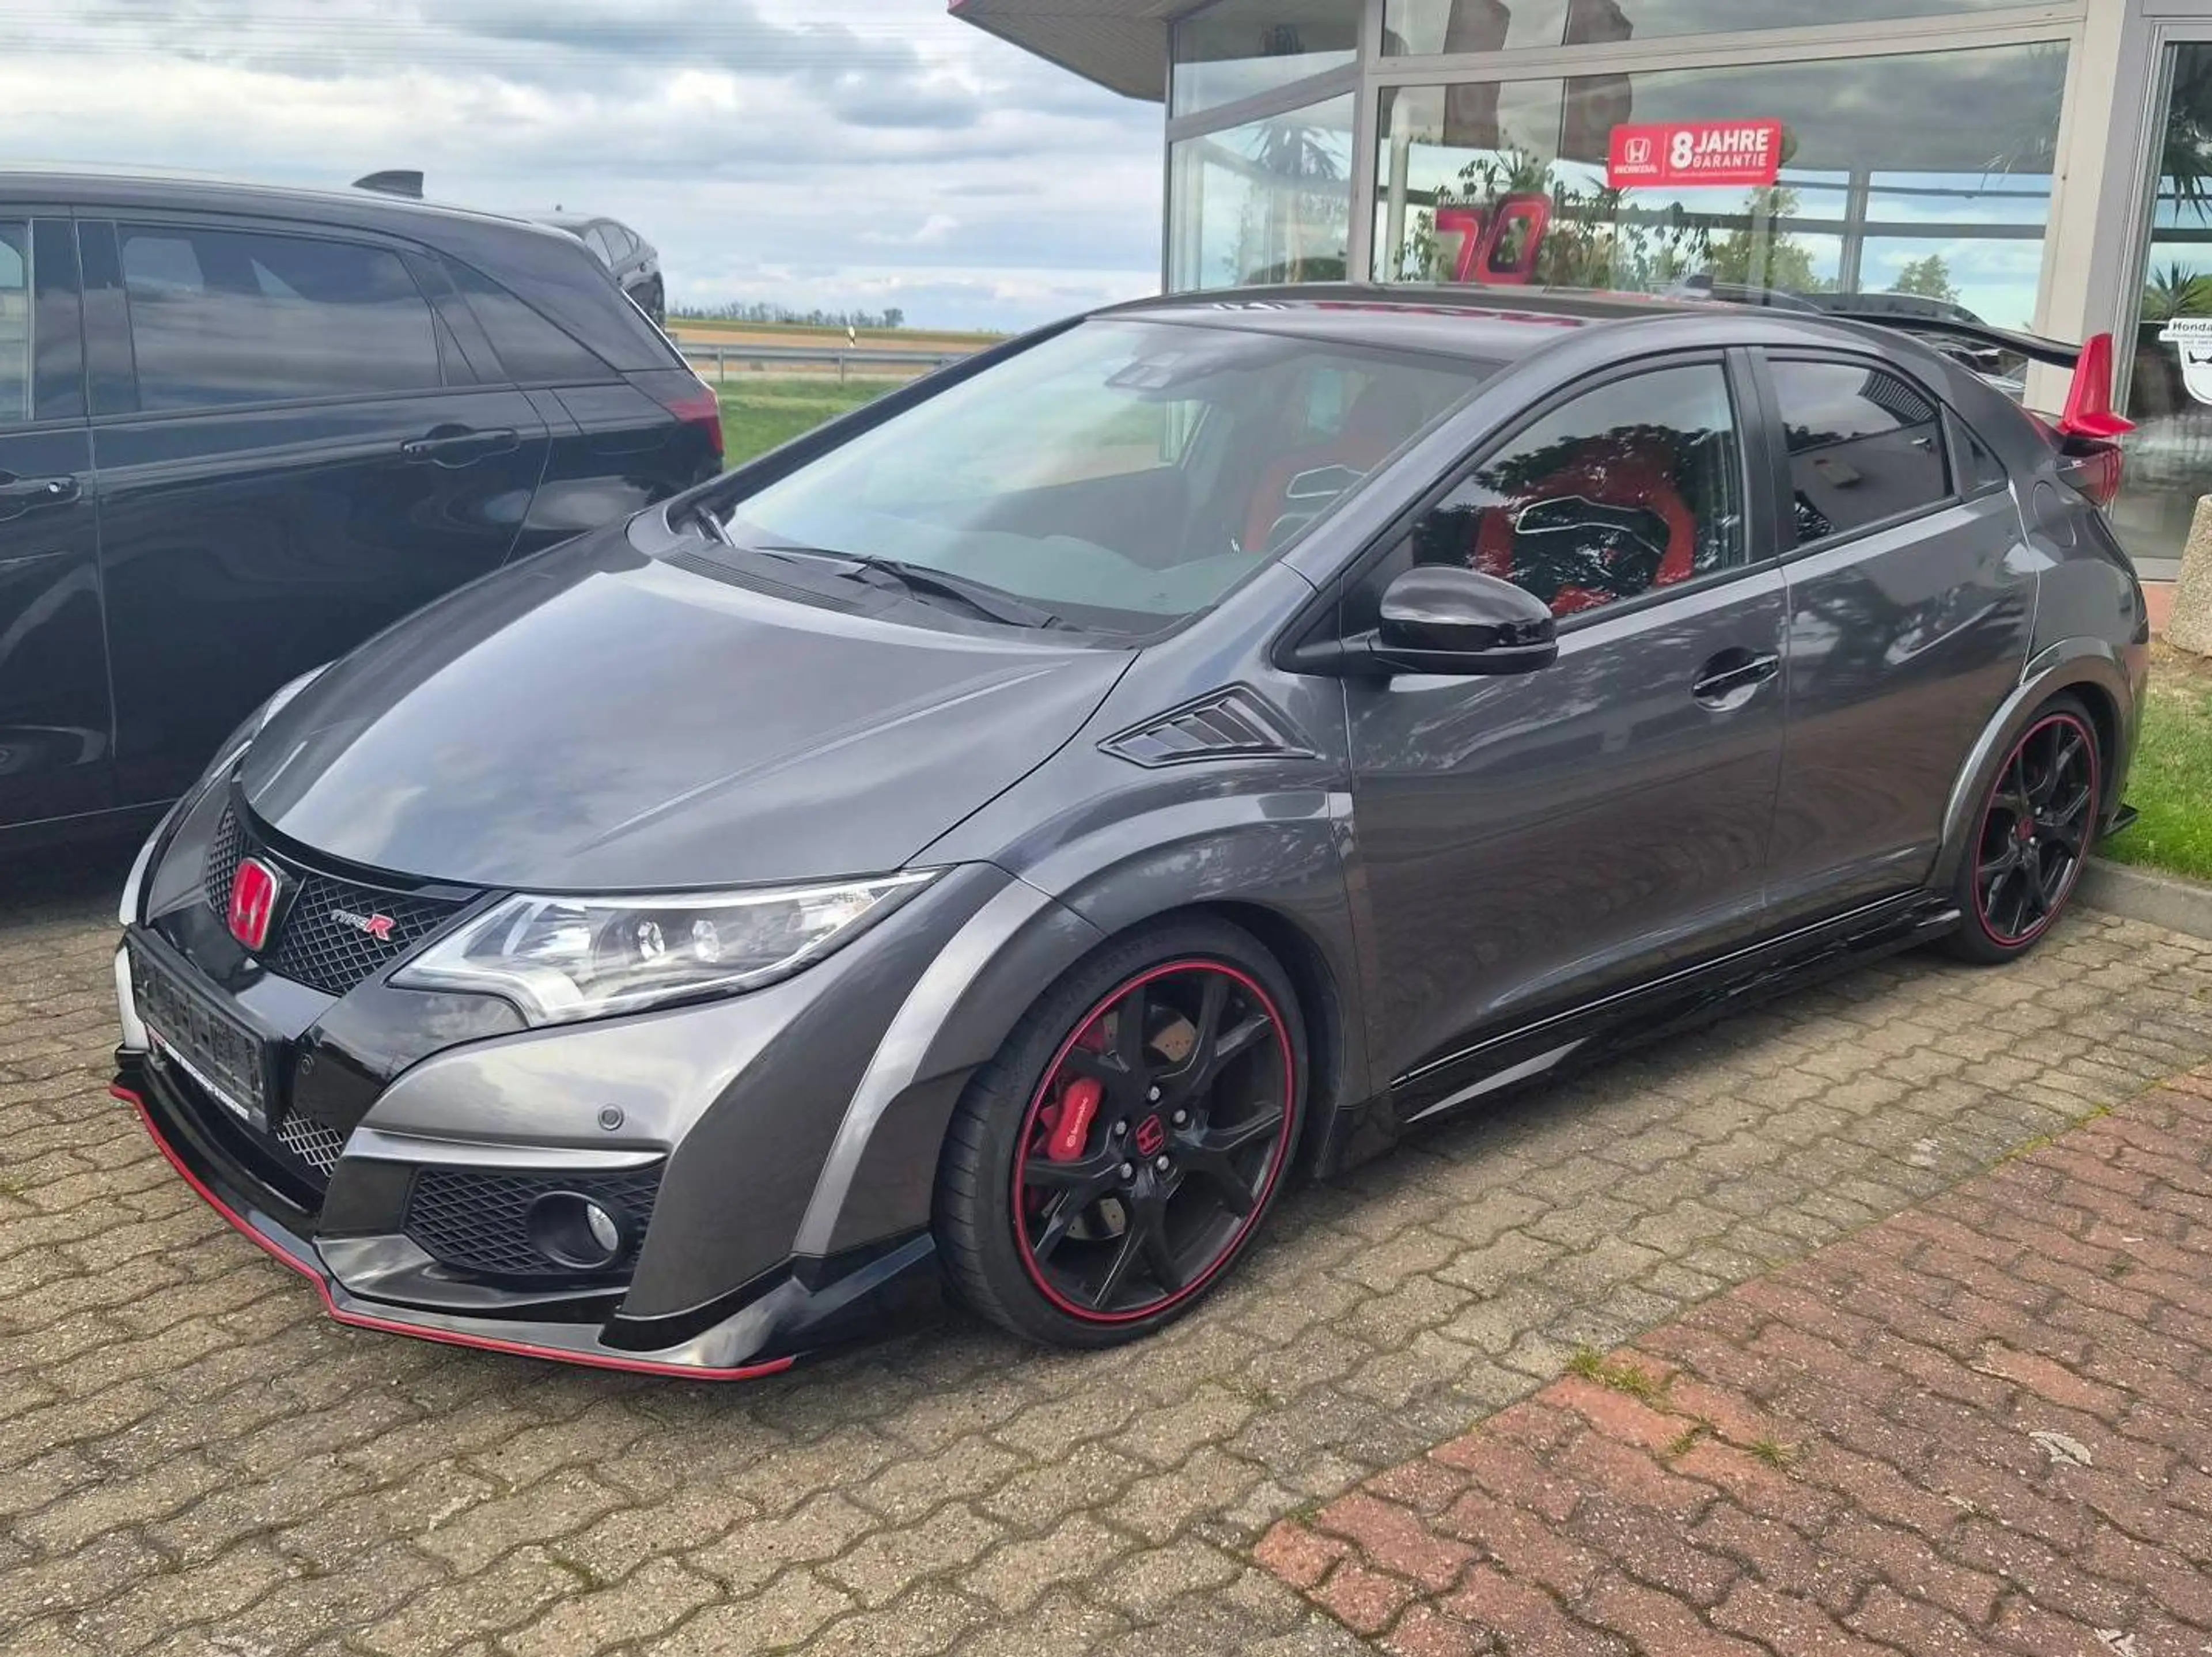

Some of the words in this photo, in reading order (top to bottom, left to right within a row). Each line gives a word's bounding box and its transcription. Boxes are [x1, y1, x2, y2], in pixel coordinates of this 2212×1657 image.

[1671, 131, 1694, 169] 8
[1694, 128, 1769, 153] JAHRE
[1693, 153, 1768, 168] GARANTIE
[1435, 192, 1552, 285] 70
